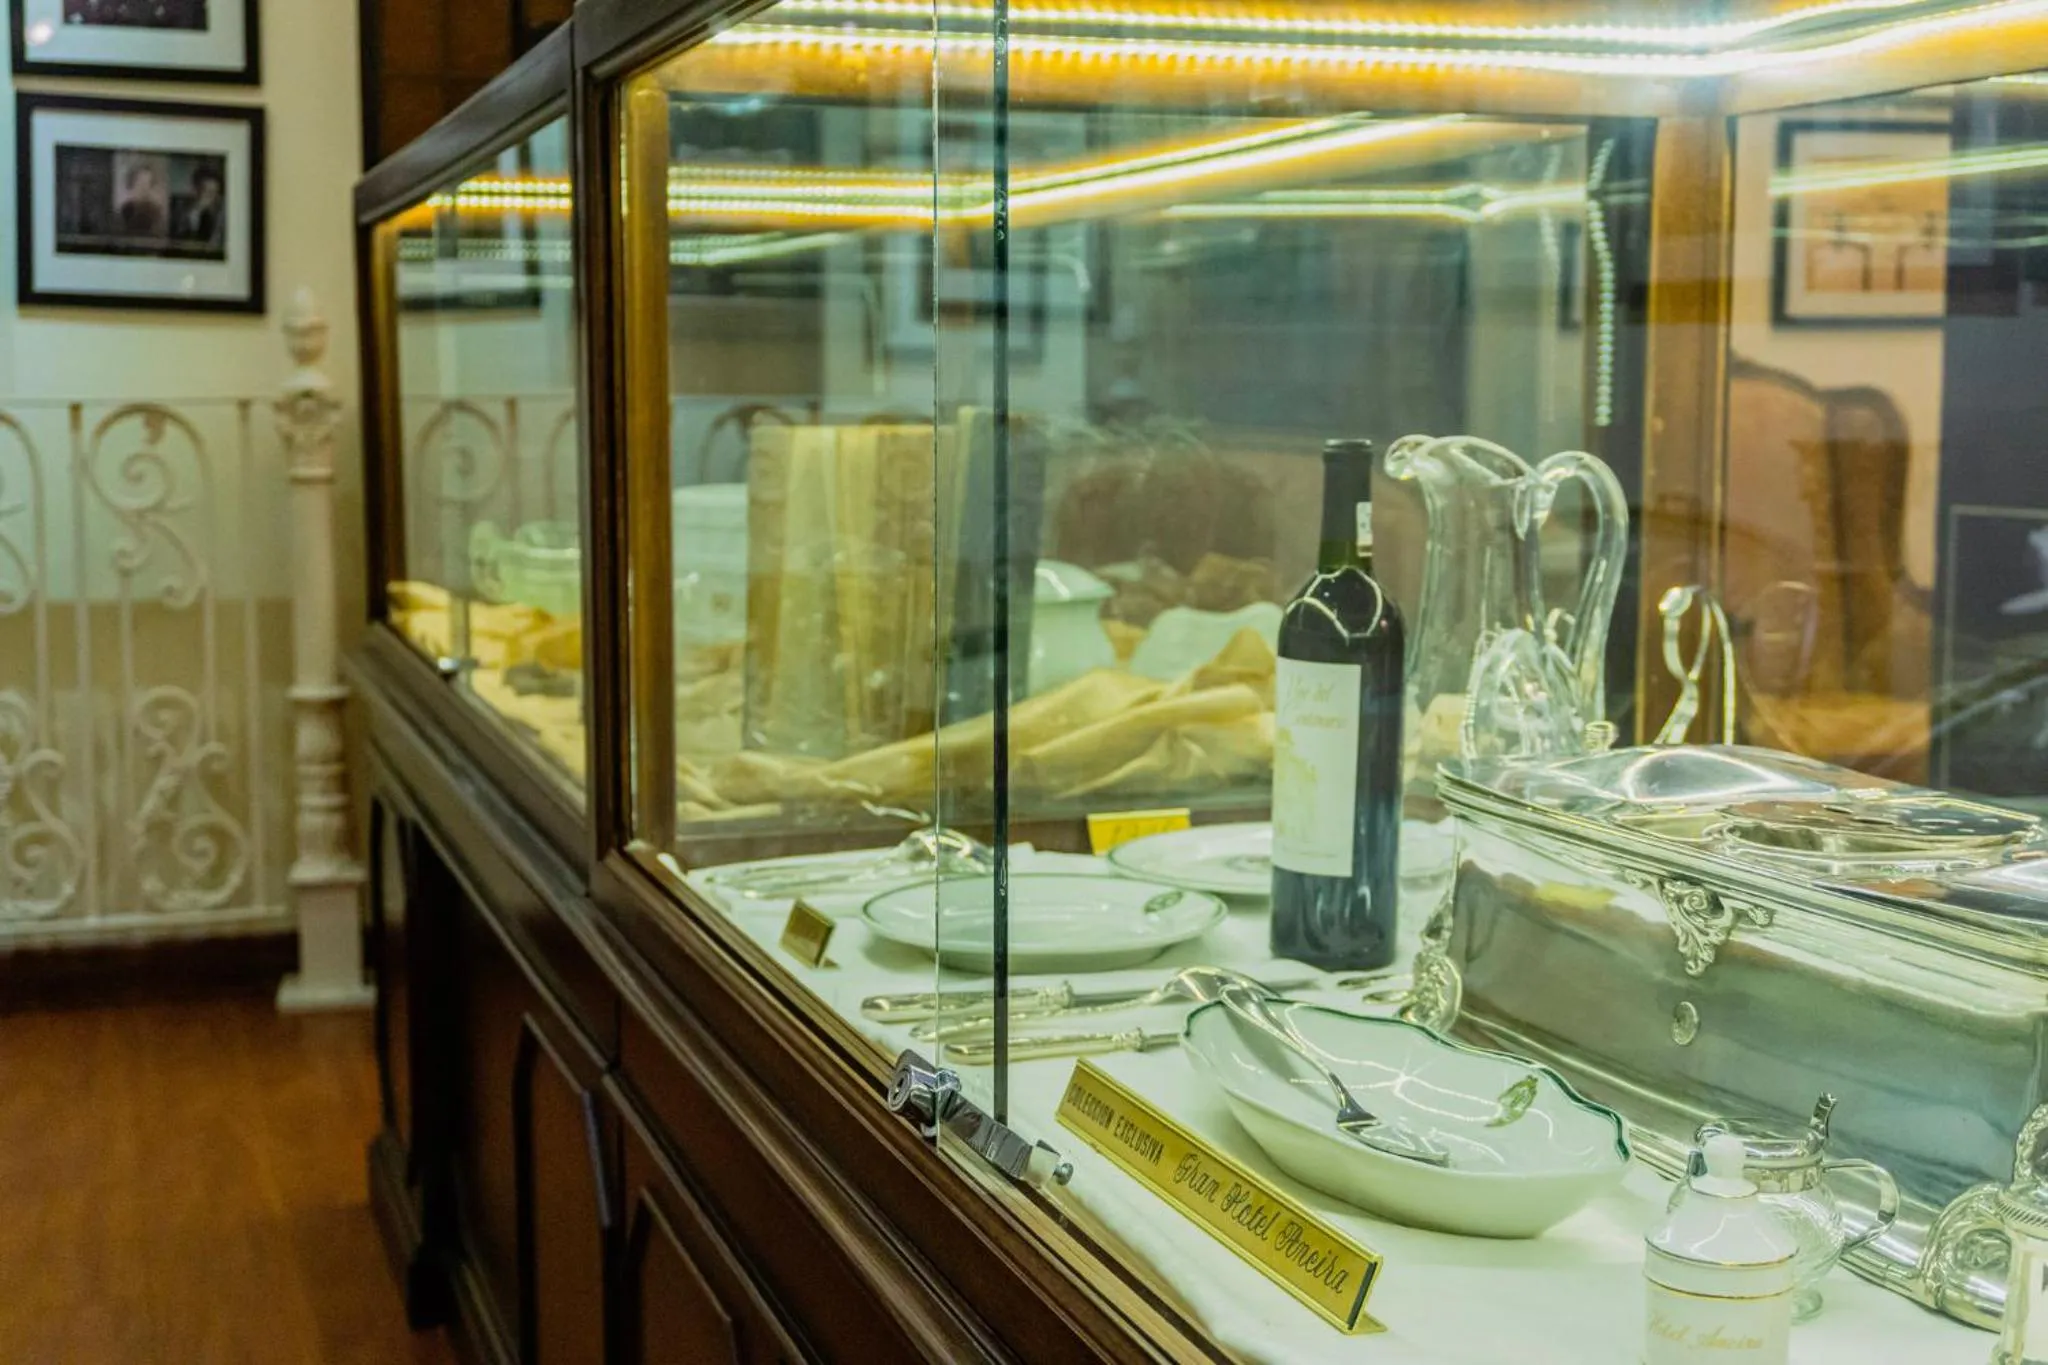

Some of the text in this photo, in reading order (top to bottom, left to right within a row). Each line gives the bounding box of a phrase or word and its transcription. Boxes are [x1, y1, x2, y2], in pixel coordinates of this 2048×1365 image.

[1113, 1114, 1165, 1167] EXCLUSIVA
[1173, 1152, 1220, 1204] Gran
[1220, 1181, 1281, 1241] Hotel
